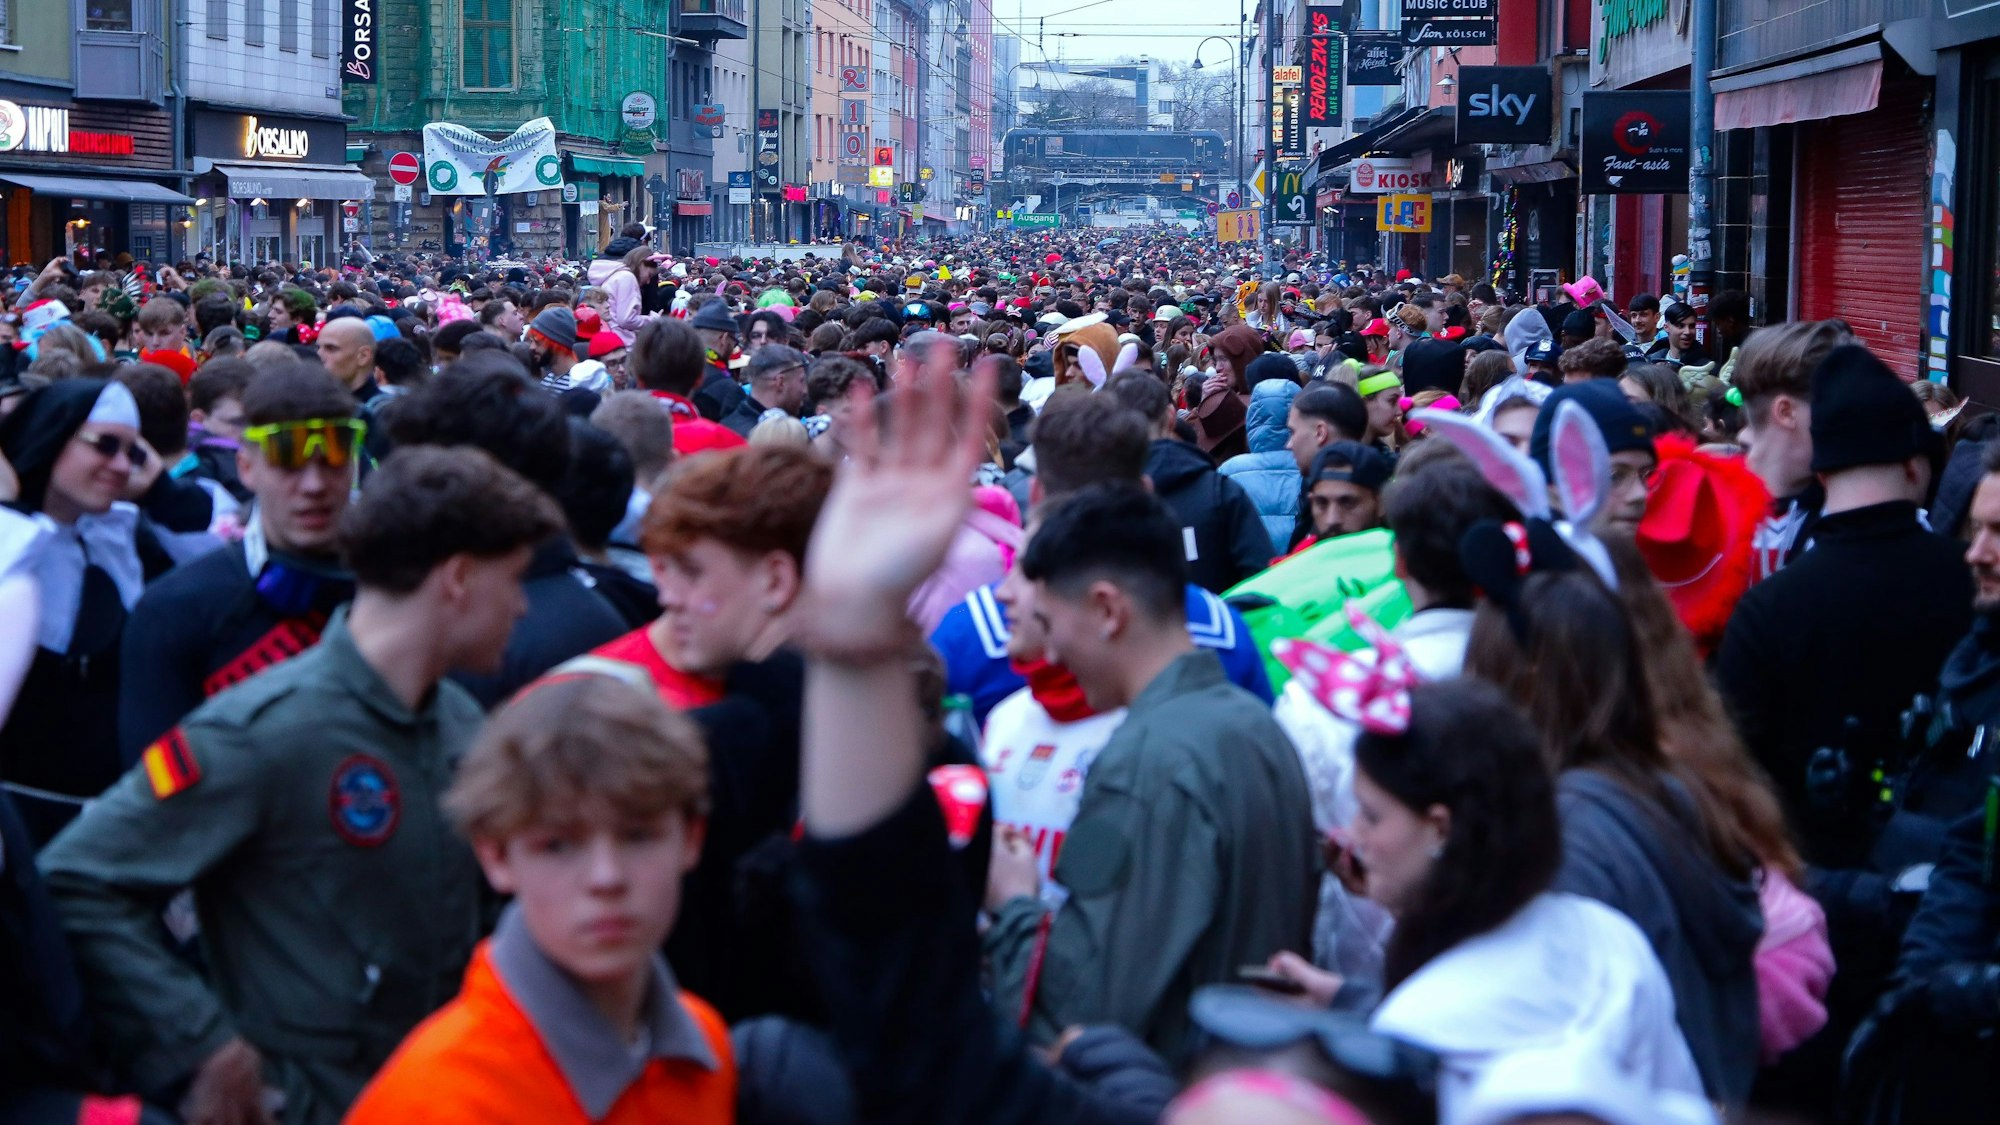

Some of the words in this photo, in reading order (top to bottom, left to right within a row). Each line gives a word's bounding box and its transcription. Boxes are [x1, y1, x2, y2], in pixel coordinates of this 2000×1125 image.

[1405, 0, 1448, 9] MUSIC
[1452, 0, 1488, 9] CLUB
[1407, 22, 1444, 43] Sion
[1446, 29, 1486, 38] KÖLSCH
[1330, 20, 1340, 69] RESTAUNT
[1310, 11, 1328, 121] RENDEZVUS
[1329, 75, 1338, 90] BAR
[1469, 83, 1537, 126] sky
[245, 115, 309, 158] BORSALINO
[1603, 155, 1671, 172] Fant-asia
[232, 181, 262, 195] BORSALINO
[1378, 173, 1432, 188] KIOSK
[1017, 213, 1055, 224] Ausgang
